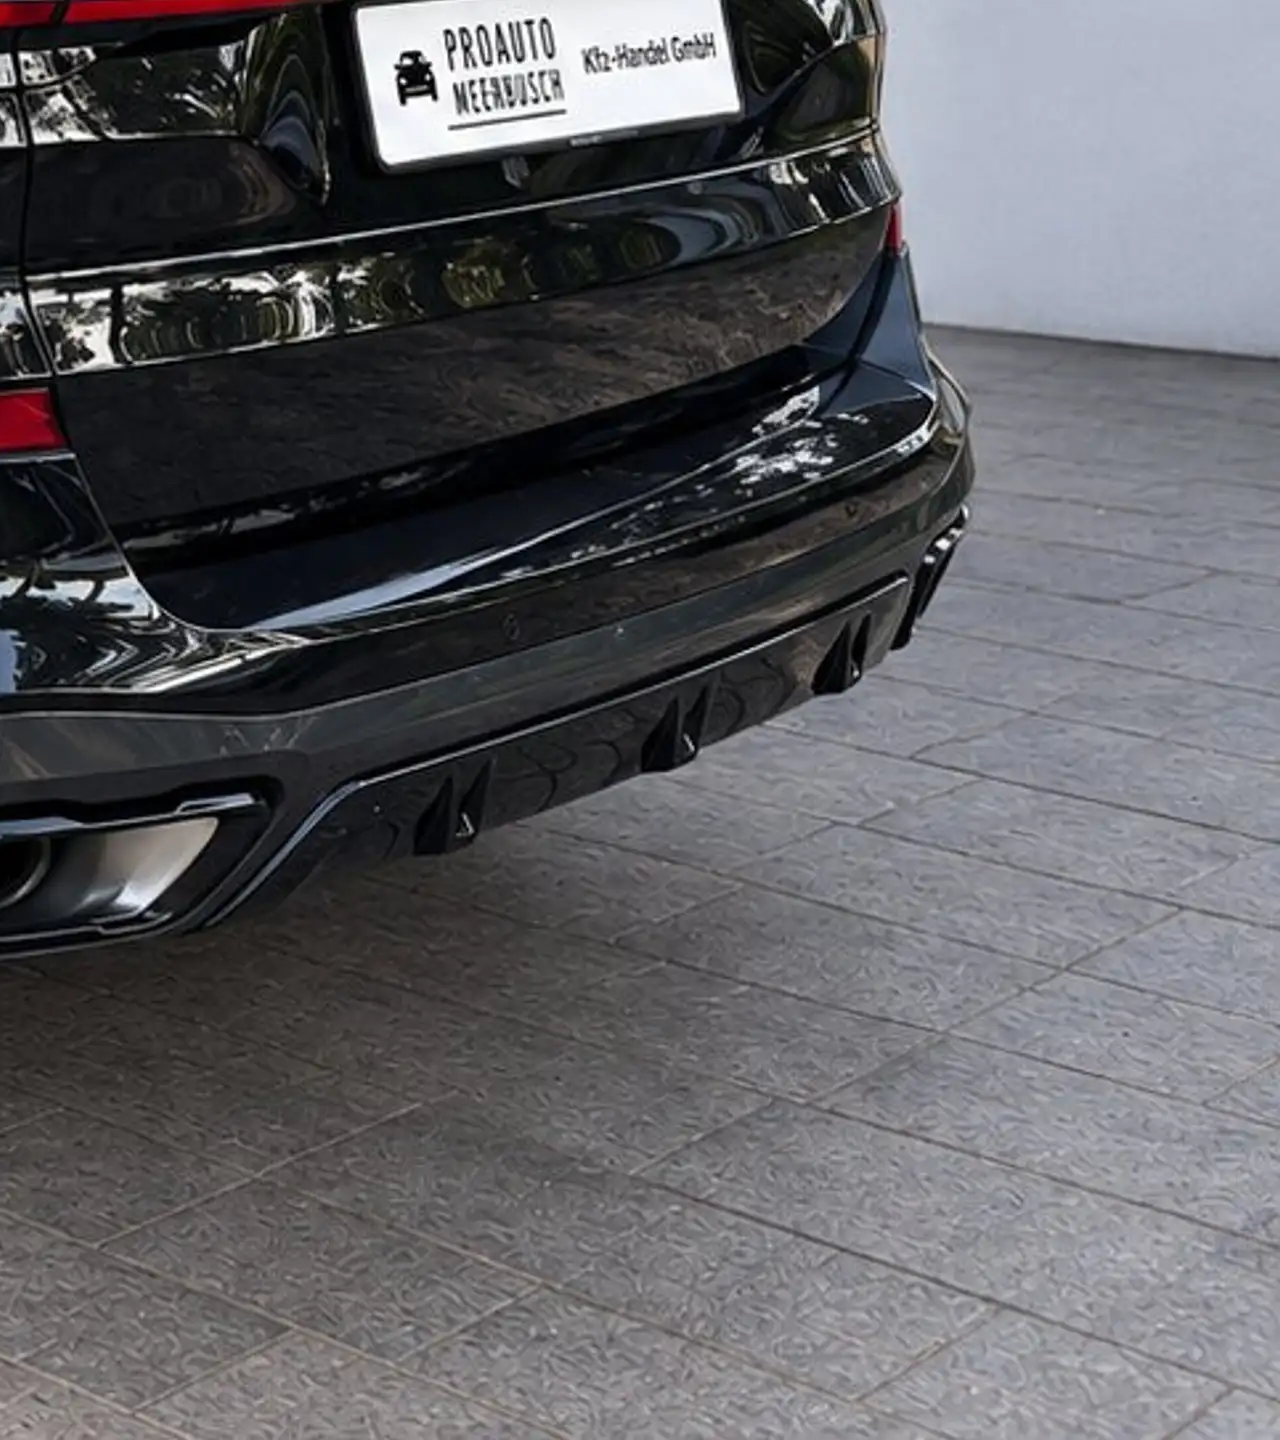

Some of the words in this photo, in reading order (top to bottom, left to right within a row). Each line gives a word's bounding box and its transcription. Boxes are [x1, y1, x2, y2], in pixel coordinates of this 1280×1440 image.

[443, 17, 556, 71] PROAUTO
[581, 37, 670, 74] Kfz-Handel
[670, 32, 716, 63] GmbH
[453, 69, 564, 115] MEERBUSCH
